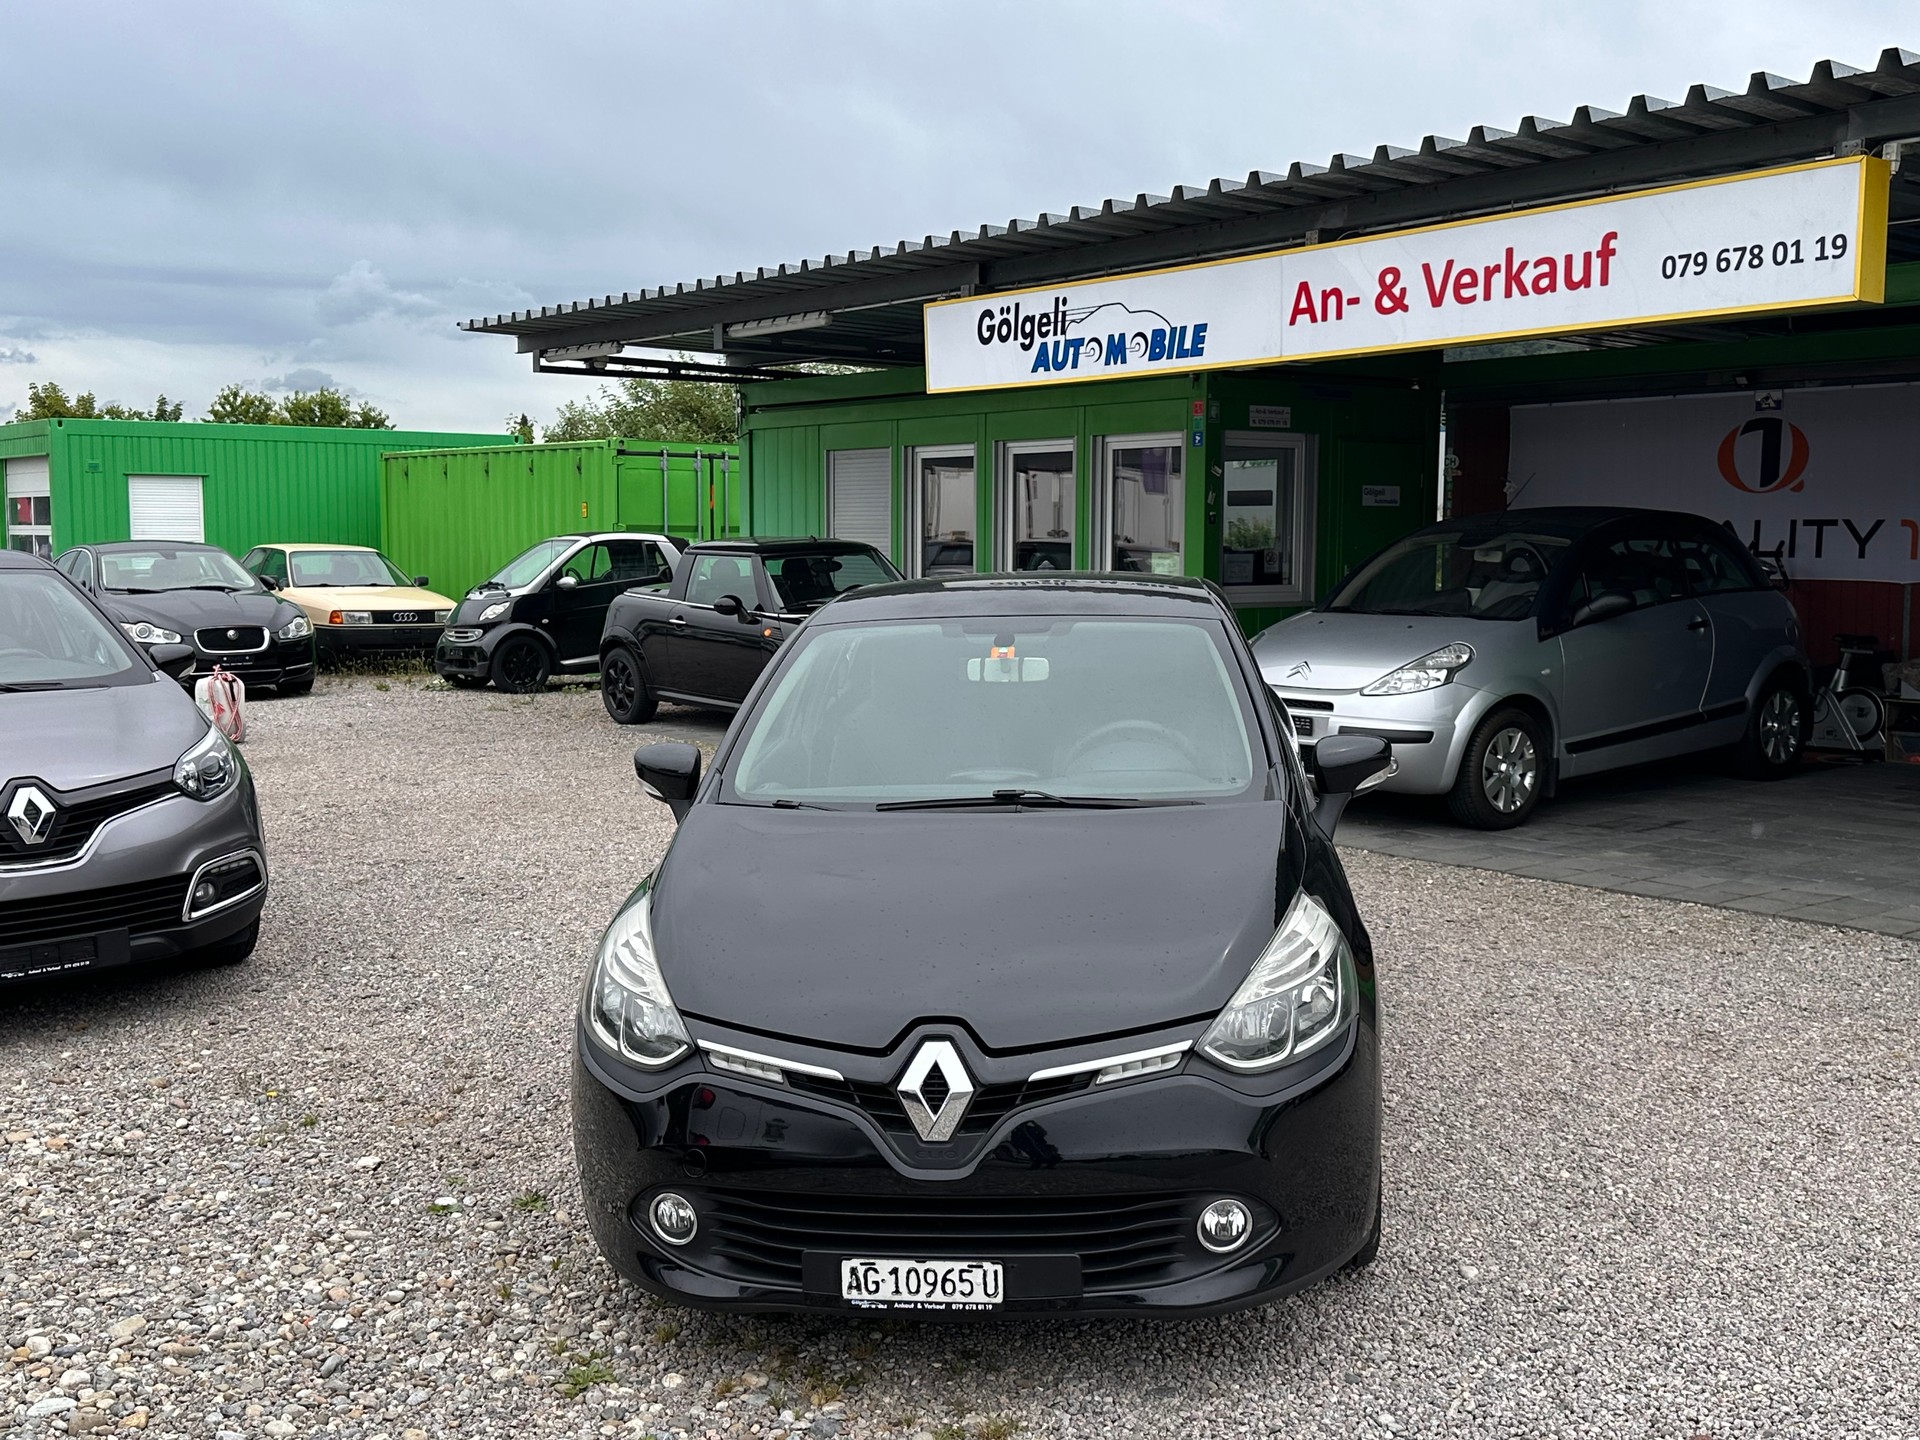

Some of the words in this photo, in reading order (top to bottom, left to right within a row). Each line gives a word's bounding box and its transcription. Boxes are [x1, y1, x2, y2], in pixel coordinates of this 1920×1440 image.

[1288, 281, 1360, 326] An-
[1375, 267, 1409, 315] &
[1422, 232, 1618, 307] Verkauf
[1661, 251, 1709, 281] 079
[1716, 245, 1764, 274] 678
[1772, 240, 1806, 268] 01
[1814, 232, 1848, 264] 19
[977, 297, 1068, 352] Gölgeli
